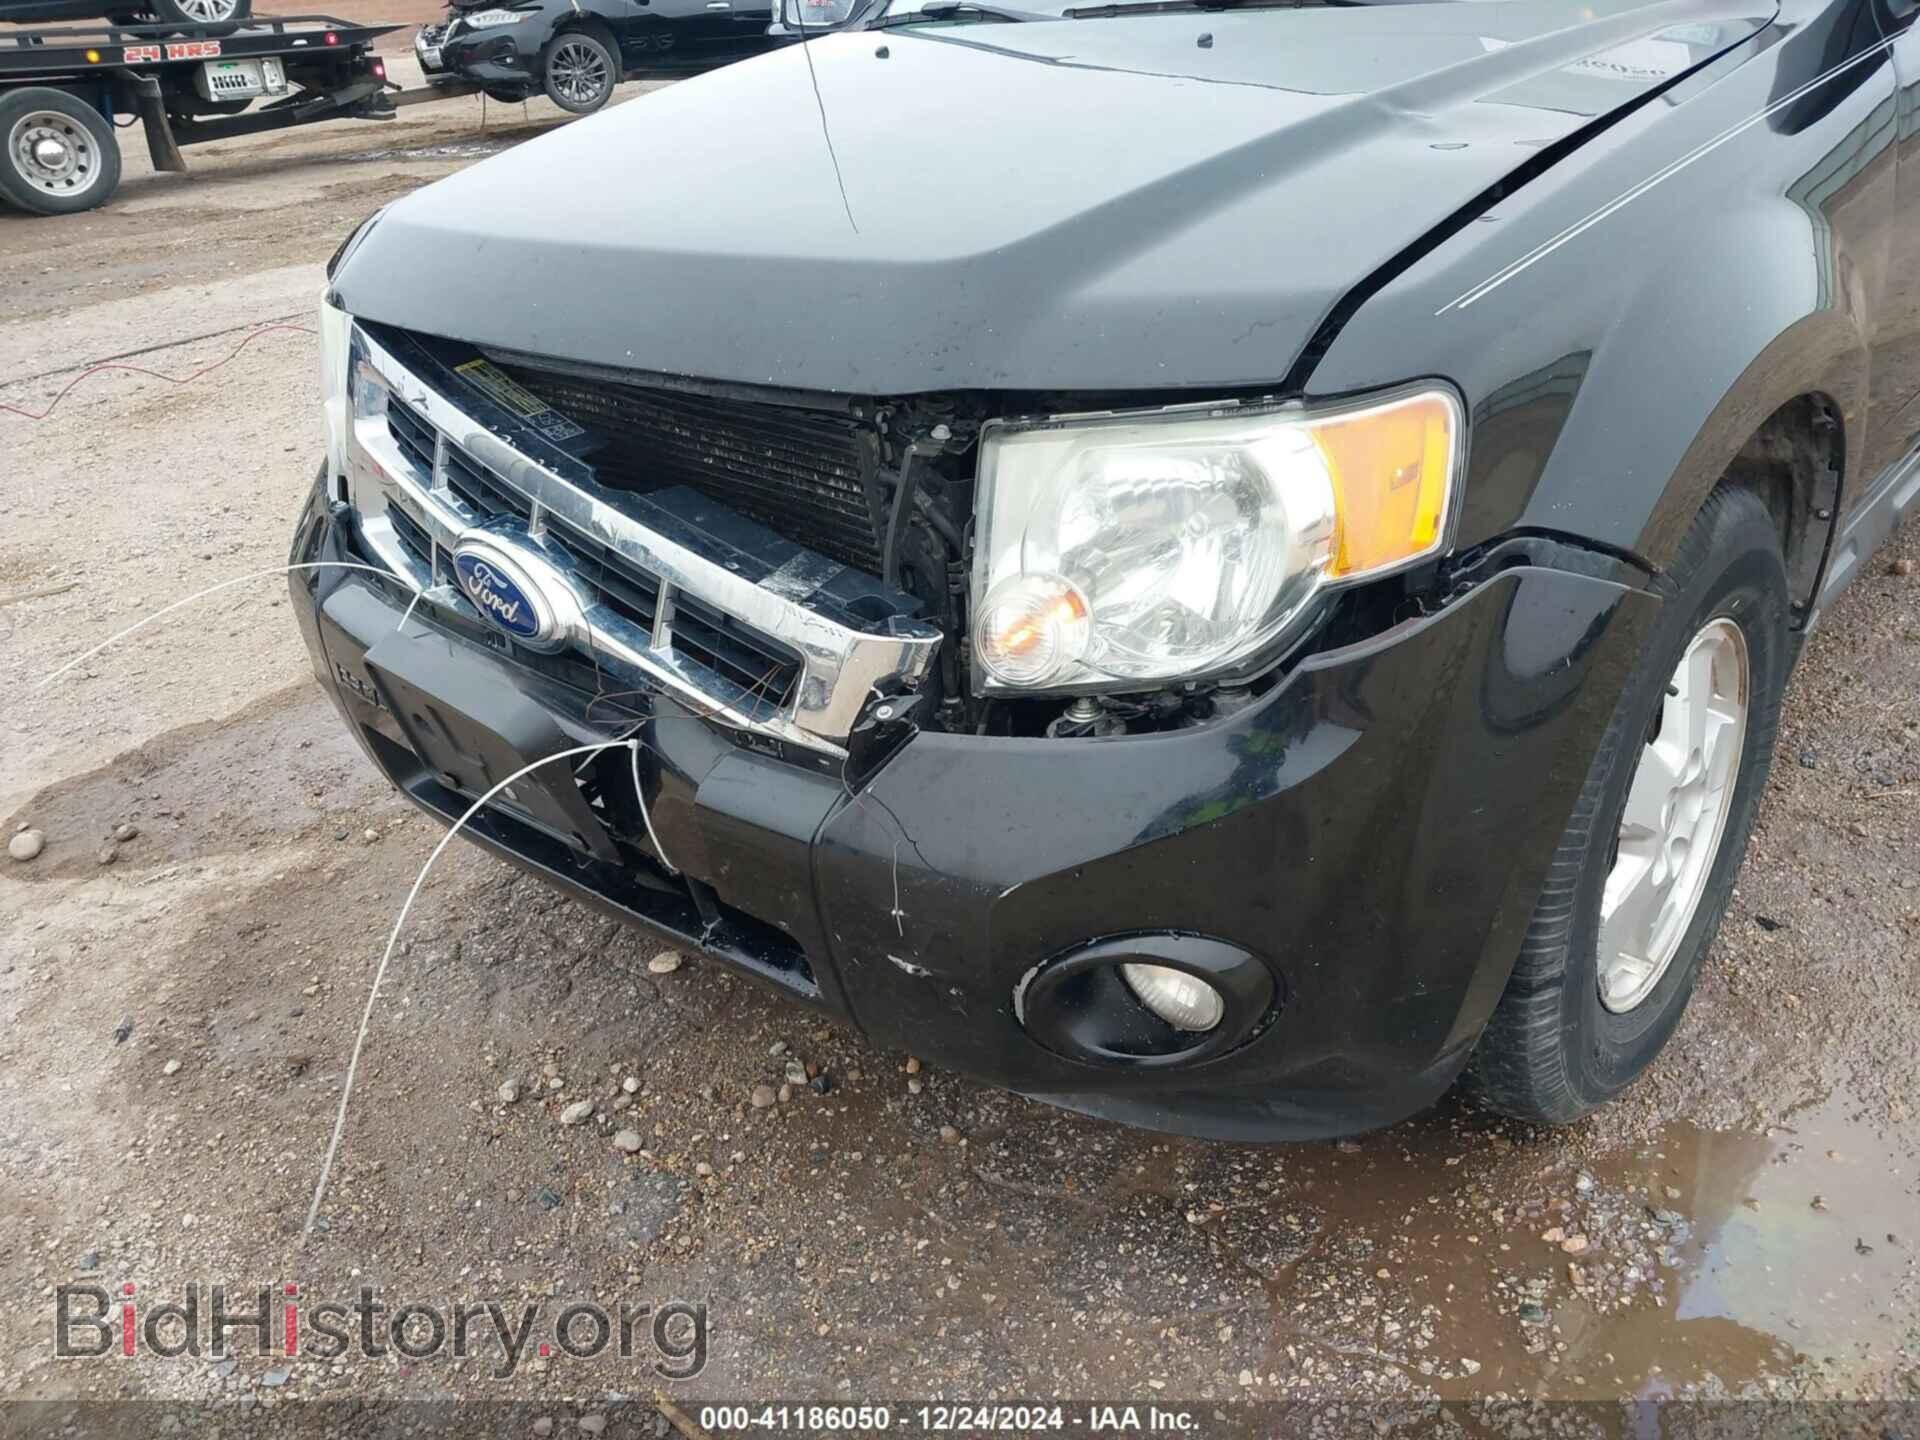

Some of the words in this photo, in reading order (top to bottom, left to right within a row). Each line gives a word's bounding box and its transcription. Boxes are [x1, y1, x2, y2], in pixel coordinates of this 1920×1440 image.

[124, 45, 161, 63] 24
[165, 41, 221, 60] HRS
[469, 562, 520, 623] Ford
